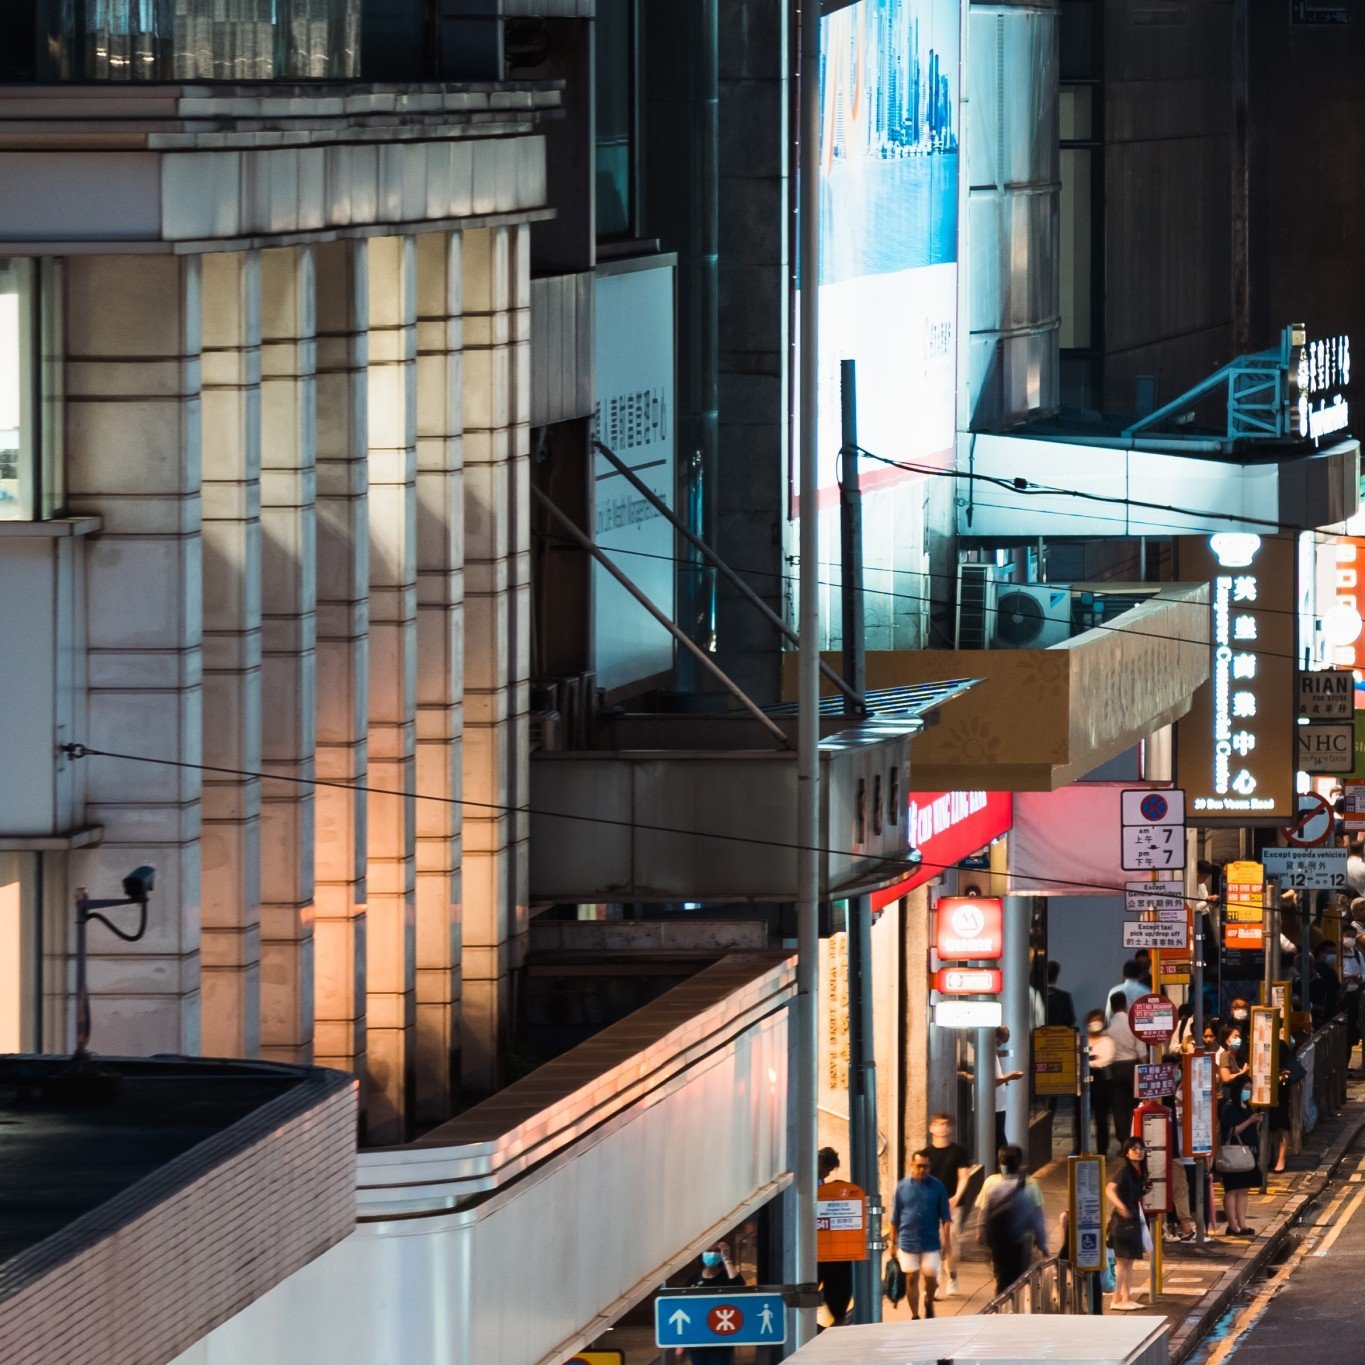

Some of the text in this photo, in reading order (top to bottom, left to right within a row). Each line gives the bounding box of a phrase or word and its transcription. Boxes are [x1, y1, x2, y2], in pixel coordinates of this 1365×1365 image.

[1135, 835, 1153, 844] 上午
[1163, 829, 1173, 844] 7
[1163, 850, 1173, 864] 7
[1264, 851, 1291, 859] Except
[1292, 851, 1316, 859] goods
[1135, 858, 1152, 867] 下午
[1289, 874, 1306, 886] 12
[1330, 874, 1345, 886] 12
